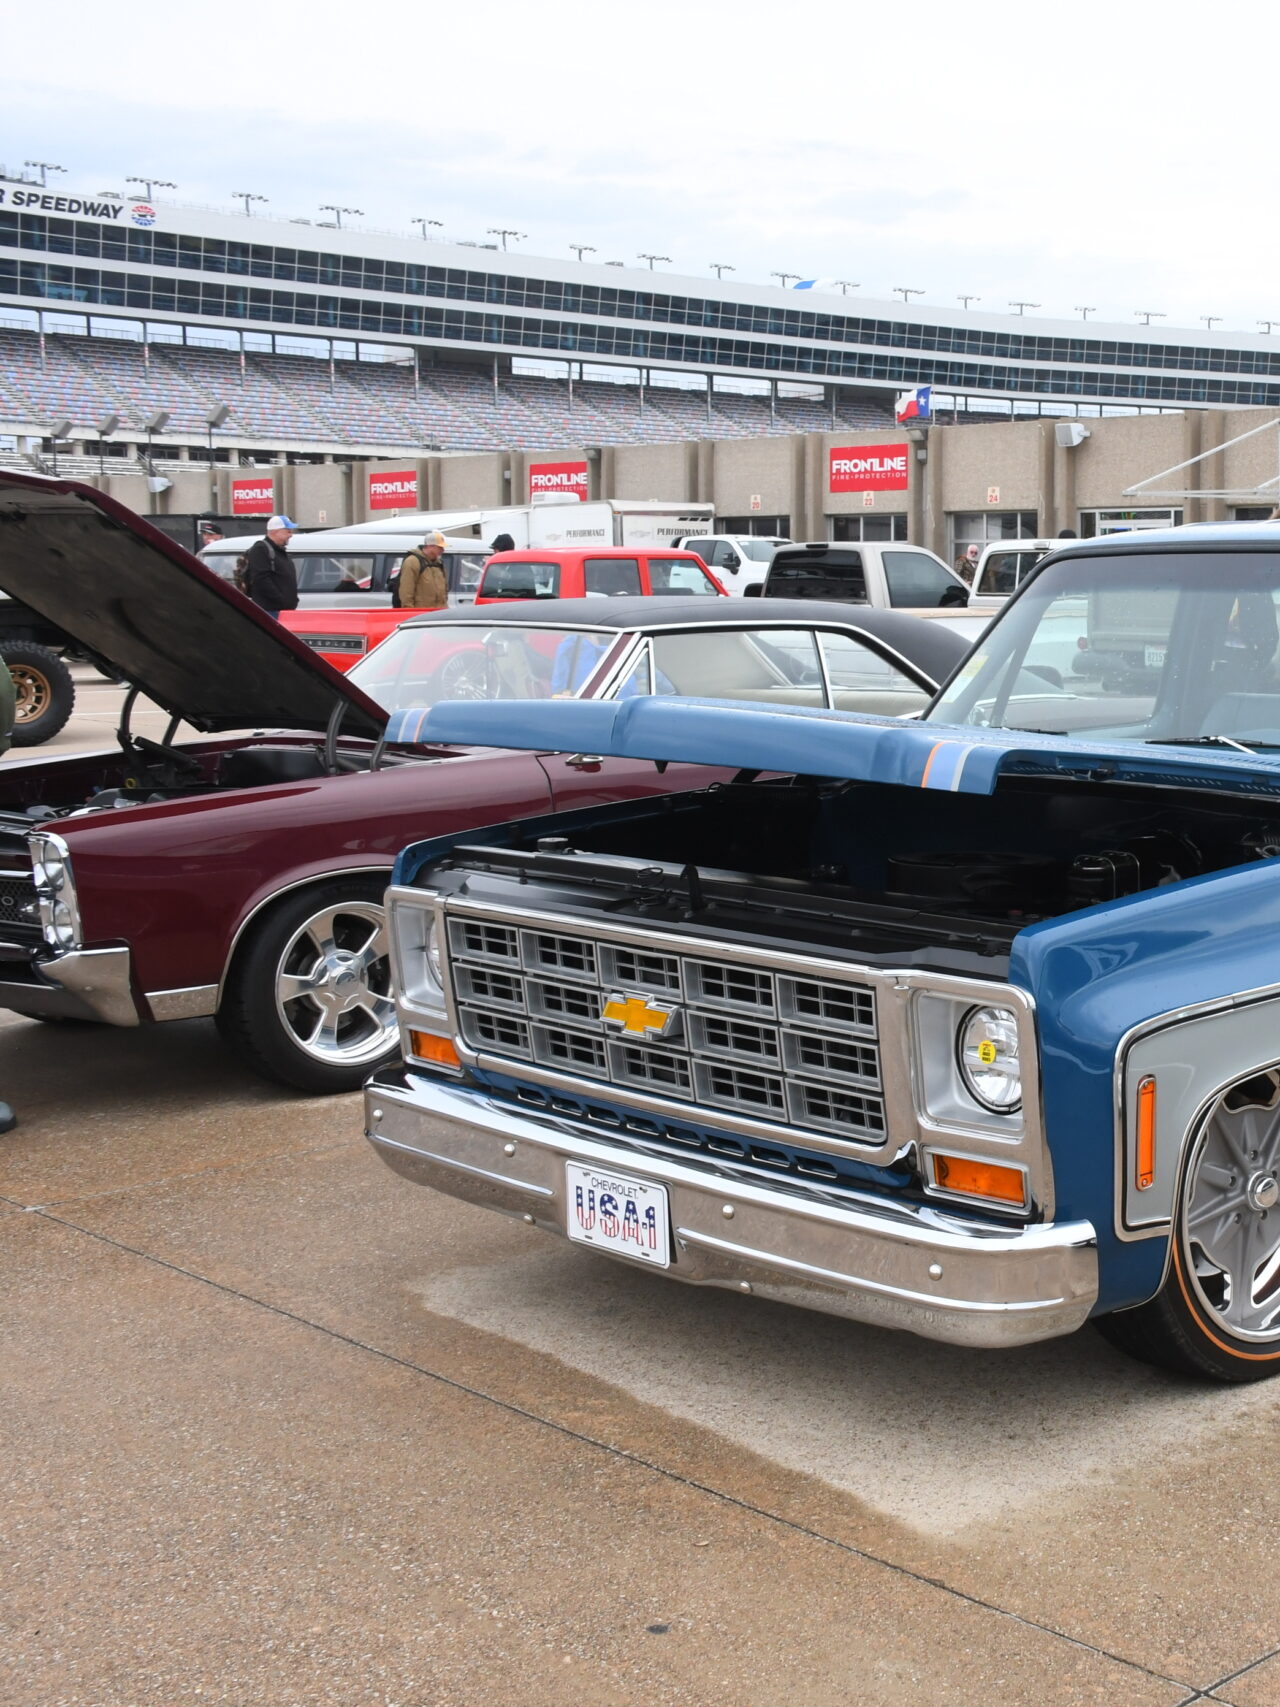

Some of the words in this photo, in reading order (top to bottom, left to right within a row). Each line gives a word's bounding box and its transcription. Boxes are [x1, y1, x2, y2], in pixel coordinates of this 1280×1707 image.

[12, 190, 124, 219] SPEEDWAY
[832, 456, 907, 473] FRONTLINE
[371, 480, 418, 494] FRONTLINE
[531, 472, 588, 487] FRONTLINE
[234, 488, 274, 500] FRONTLINE
[591, 1177, 638, 1198] CHEVROLET
